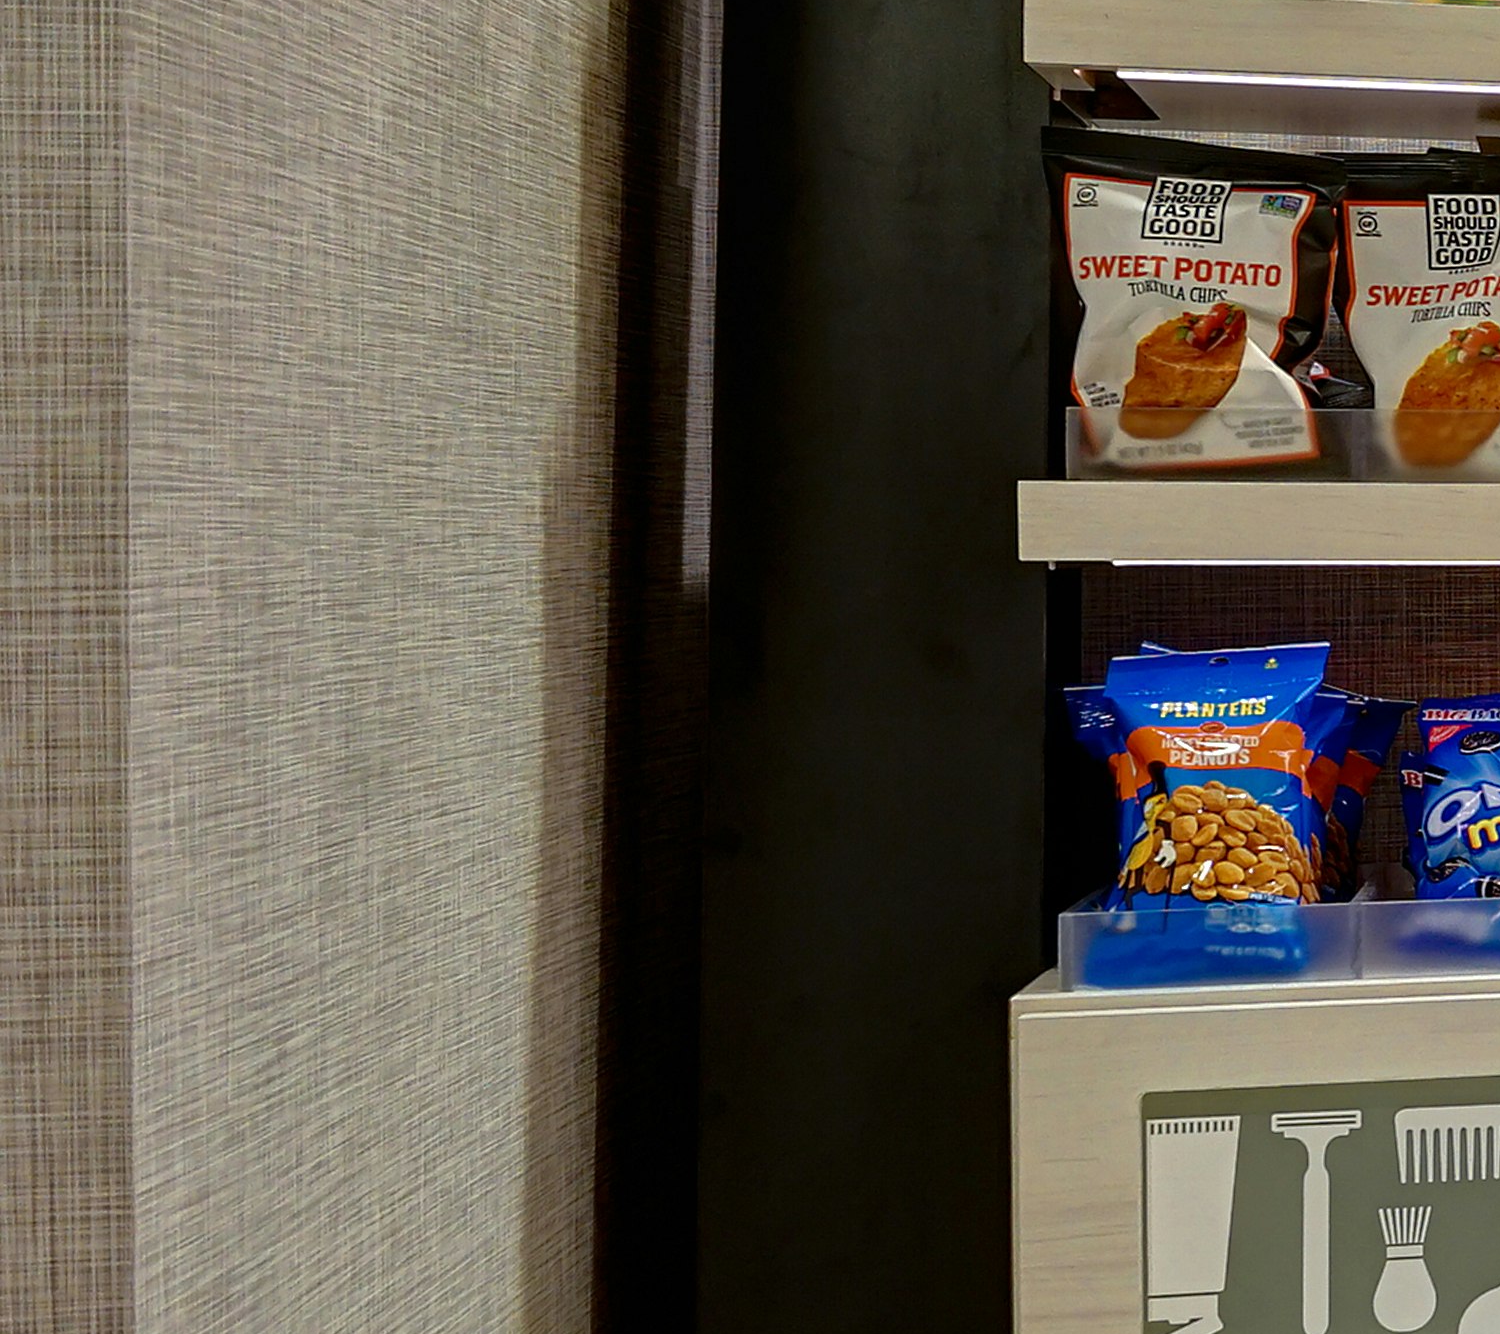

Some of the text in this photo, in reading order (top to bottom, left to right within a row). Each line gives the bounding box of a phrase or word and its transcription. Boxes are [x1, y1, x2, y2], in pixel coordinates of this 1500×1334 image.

[1157, 180, 1227, 198] FOOD
[1154, 193, 1224, 207] SHOULD
[1432, 197, 1498, 215] FOOD
[1151, 204, 1217, 220] TASTE
[1149, 218, 1216, 238] GOOD
[1432, 214, 1498, 231] SHOULD
[1433, 230, 1495, 248] TASTE
[1435, 247, 1492, 265] GOOD
[1079, 255, 1282, 288] SWEET POTATO
[1127, 279, 1228, 304] TORTILLA CHIPS
[1366, 282, 1449, 307] SWEET
[1410, 301, 1491, 325] TORTILLA CHIPS
[1160, 699, 1267, 718] PLANTERS
[1169, 748, 1250, 766] PEANUTS
